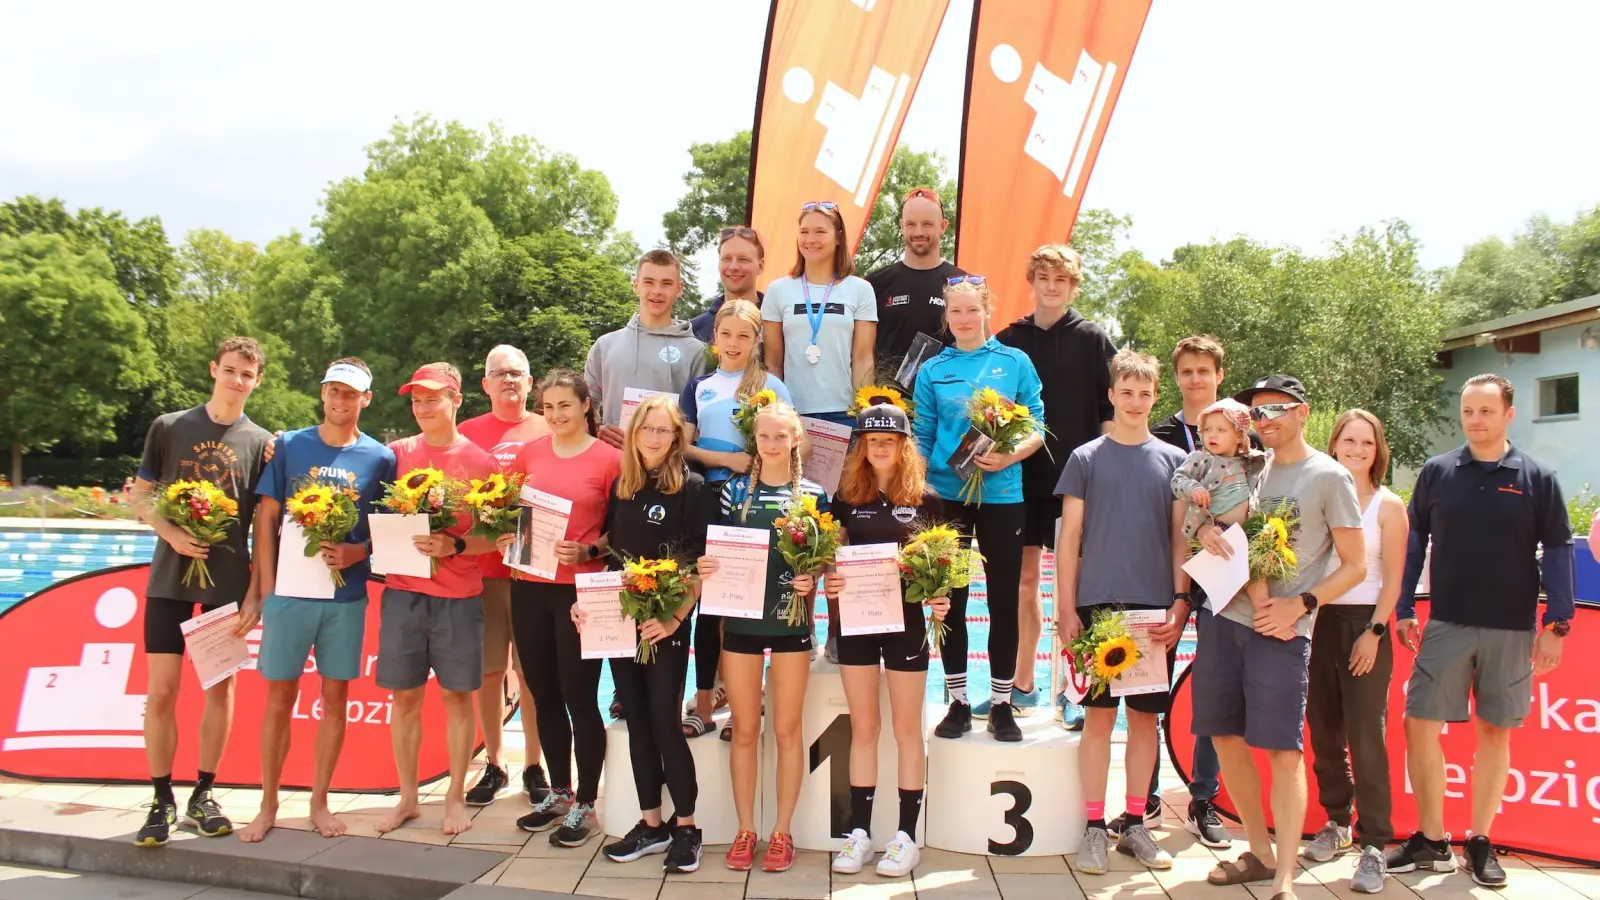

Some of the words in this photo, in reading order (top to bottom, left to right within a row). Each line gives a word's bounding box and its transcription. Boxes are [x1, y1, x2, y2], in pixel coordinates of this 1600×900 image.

[193, 440, 239, 464] SAILFISH
[319, 466, 348, 480] RUN
[101, 649, 111, 664] 1
[45, 673, 58, 688] 2
[810, 714, 851, 838] 1
[988, 780, 1034, 856] 3
